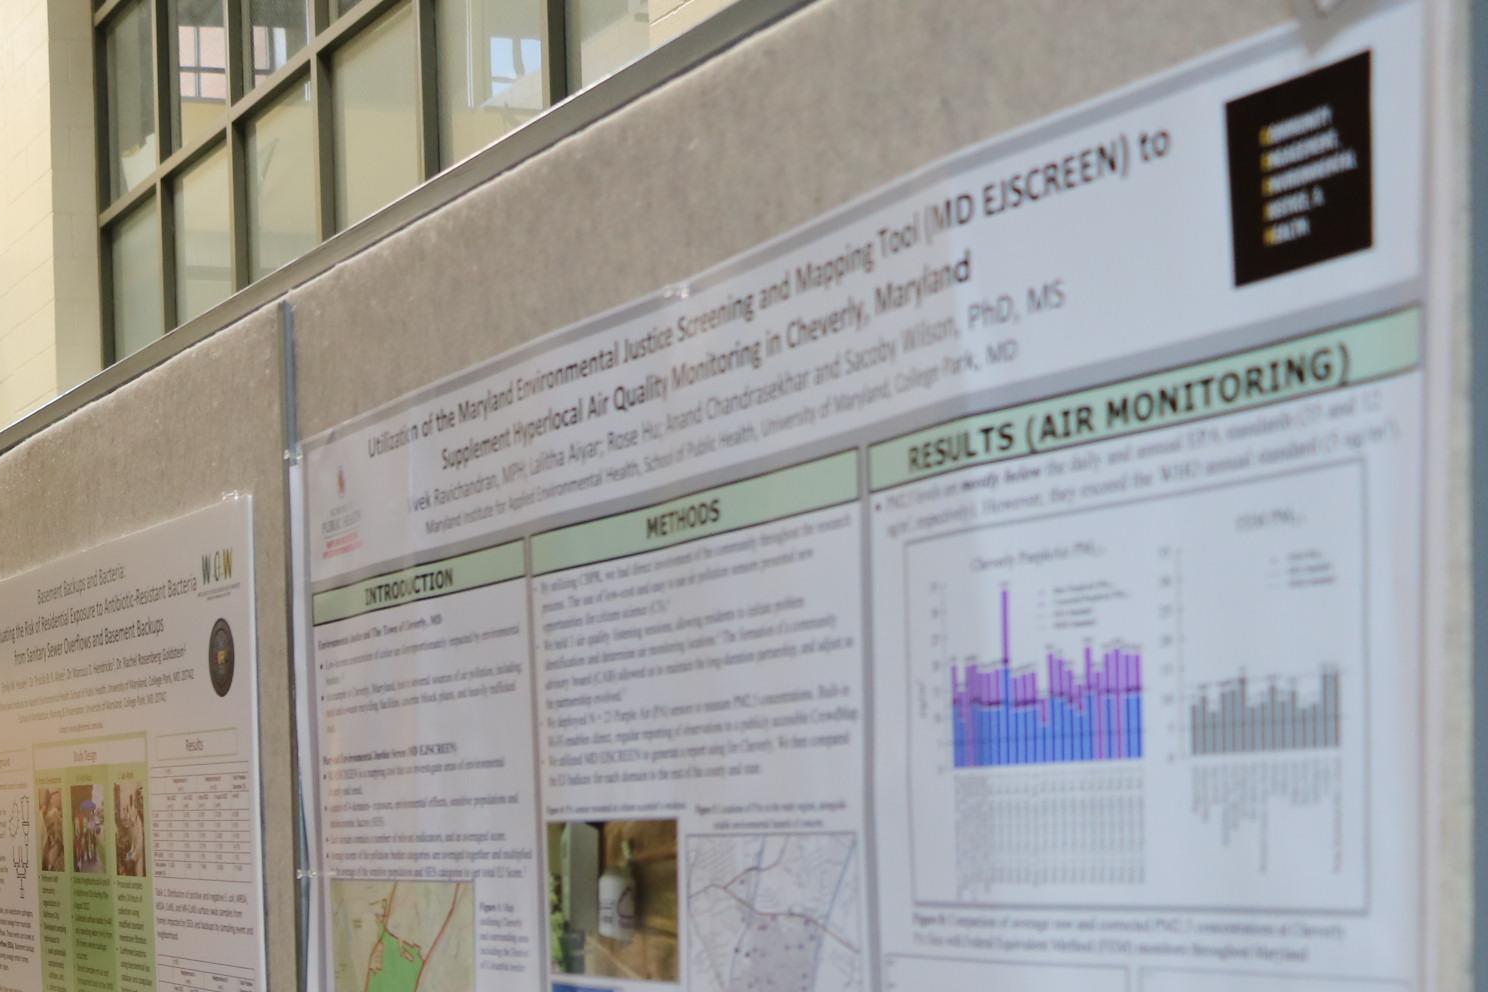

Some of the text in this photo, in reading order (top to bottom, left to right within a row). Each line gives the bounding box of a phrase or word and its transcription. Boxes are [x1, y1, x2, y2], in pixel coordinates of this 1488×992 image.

[421, 413, 436, 437] of
[436, 408, 456, 431] the
[458, 382, 514, 425] Maryland
[516, 343, 619, 399] Environmental
[622, 327, 673, 365] Justice
[677, 294, 755, 342] Screening
[759, 273, 791, 307] and
[795, 244, 874, 291] Mapping
[877, 212, 920, 257] Tool
[923, 193, 975, 245] (MD
[982, 132, 1130, 217] EJSCREEN)
[1139, 129, 1172, 162] to
[441, 248, 972, 470] Supplement Hyperlocal Air Quality Monitoring in Cheverly, Maryland
[606, 428, 639, 451] Rose
[811, 357, 841, 386] and
[1026, 277, 1066, 315] MS
[908, 341, 1350, 472] RESULTS (AIR MONITORING)
[645, 498, 721, 539] METHODS
[167, 572, 198, 599] Bacteria
[364, 567, 454, 606] INTRODUCTION
[92, 630, 103, 648] and
[104, 622, 136, 645] Basement
[136, 615, 165, 637] Backups
